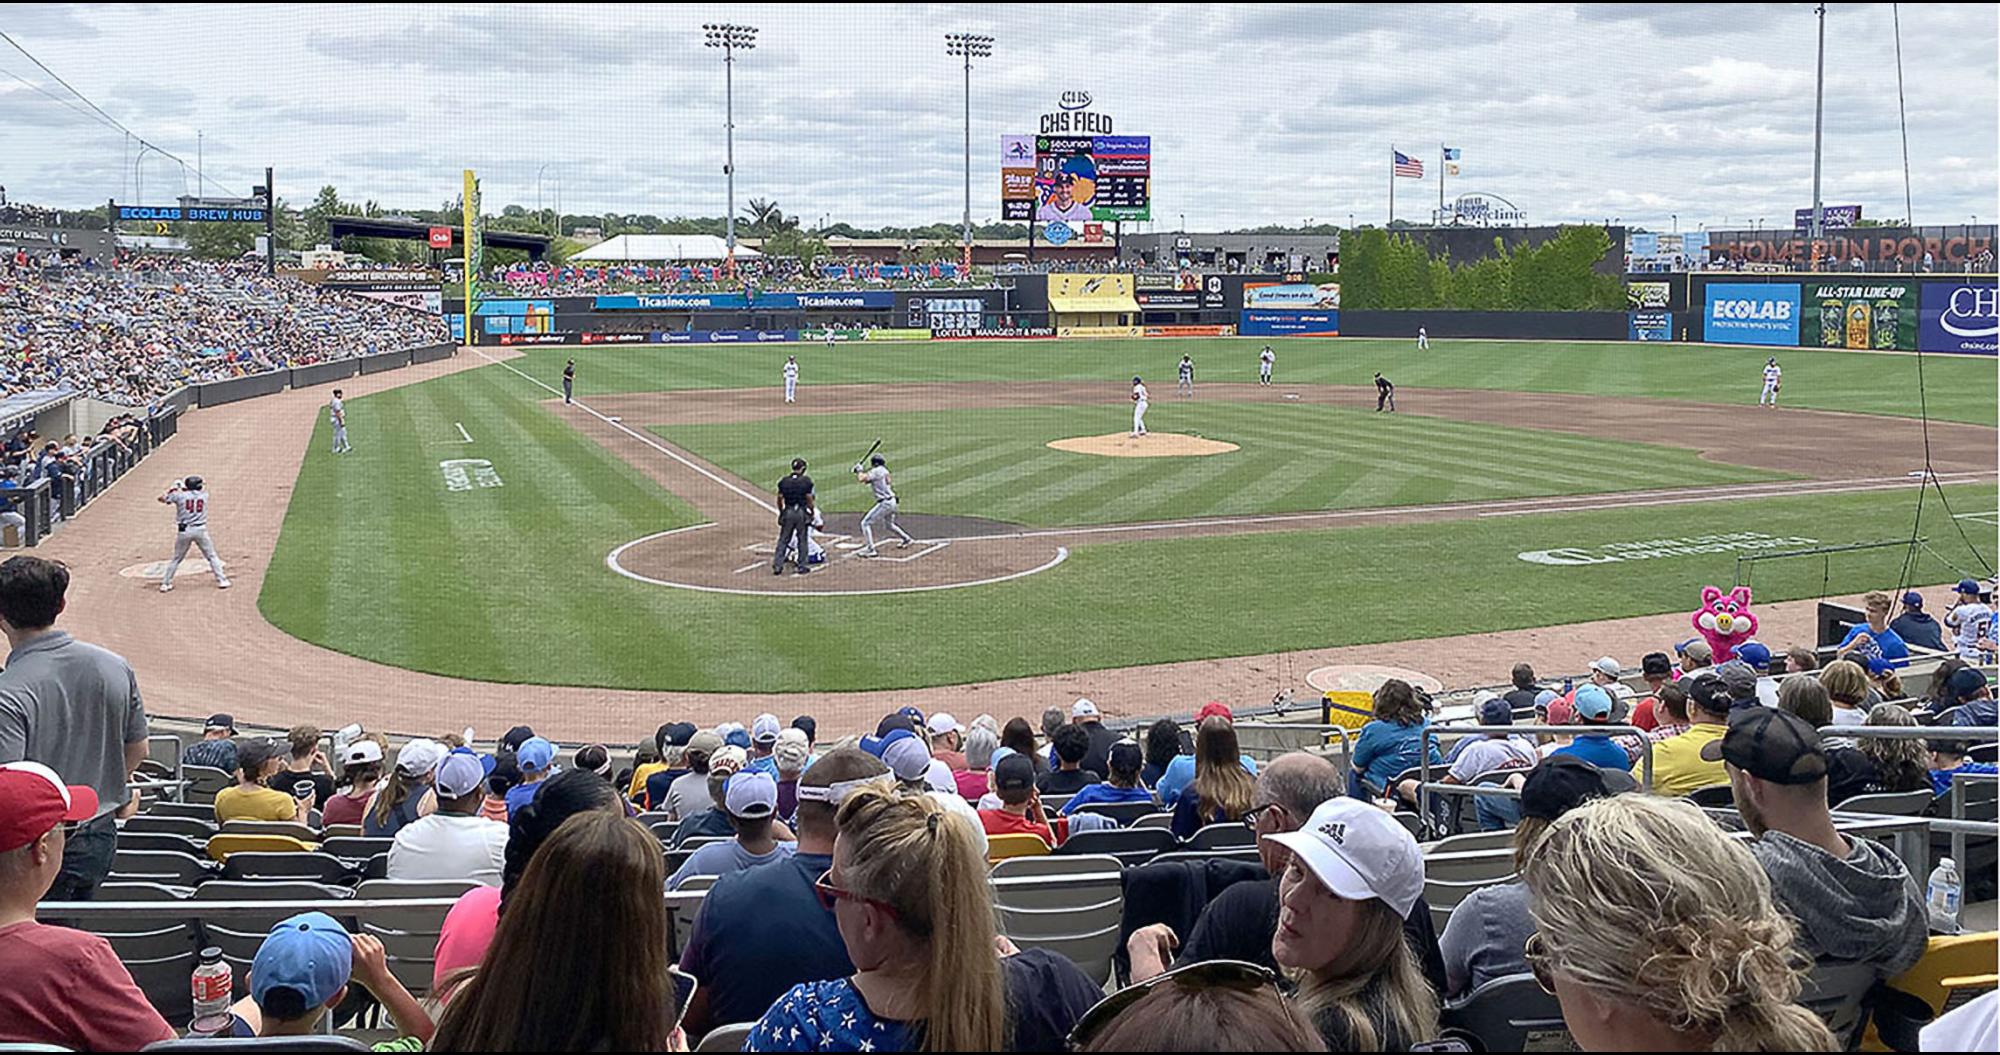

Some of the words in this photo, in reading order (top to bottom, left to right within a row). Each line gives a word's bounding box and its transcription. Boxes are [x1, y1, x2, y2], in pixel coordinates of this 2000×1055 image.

[1040, 111, 1070, 134] CHS
[1074, 111, 1113, 135] FIELD
[121, 208, 181, 219] ECOLAB
[190, 209, 228, 220] BREW
[233, 210, 262, 220] HUB
[1816, 287, 1862, 298] ALL-STAR
[1863, 287, 1906, 298] LINE-UP
[1713, 300, 1792, 321] ECOLAB
